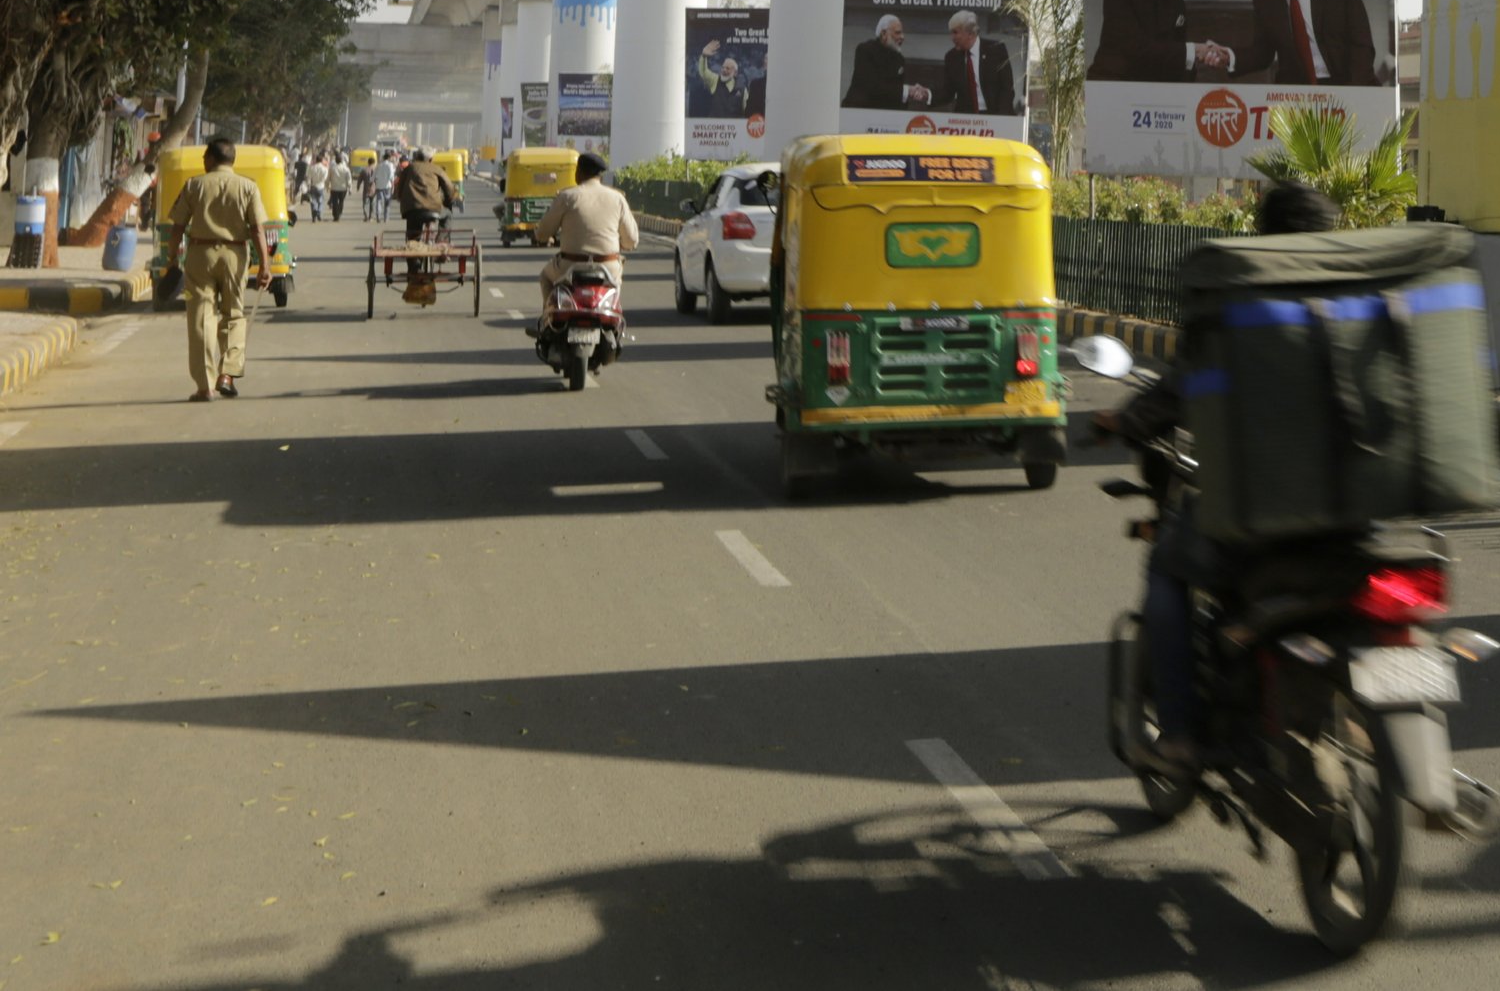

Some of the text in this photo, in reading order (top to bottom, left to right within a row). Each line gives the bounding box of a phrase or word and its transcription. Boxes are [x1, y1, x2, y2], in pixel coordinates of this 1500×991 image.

[1132, 110, 1186, 128] 24 February
[1154, 120, 1173, 129] 2020
[694, 123, 725, 131] WELCOME
[928, 168, 982, 181] FOR LIFE
